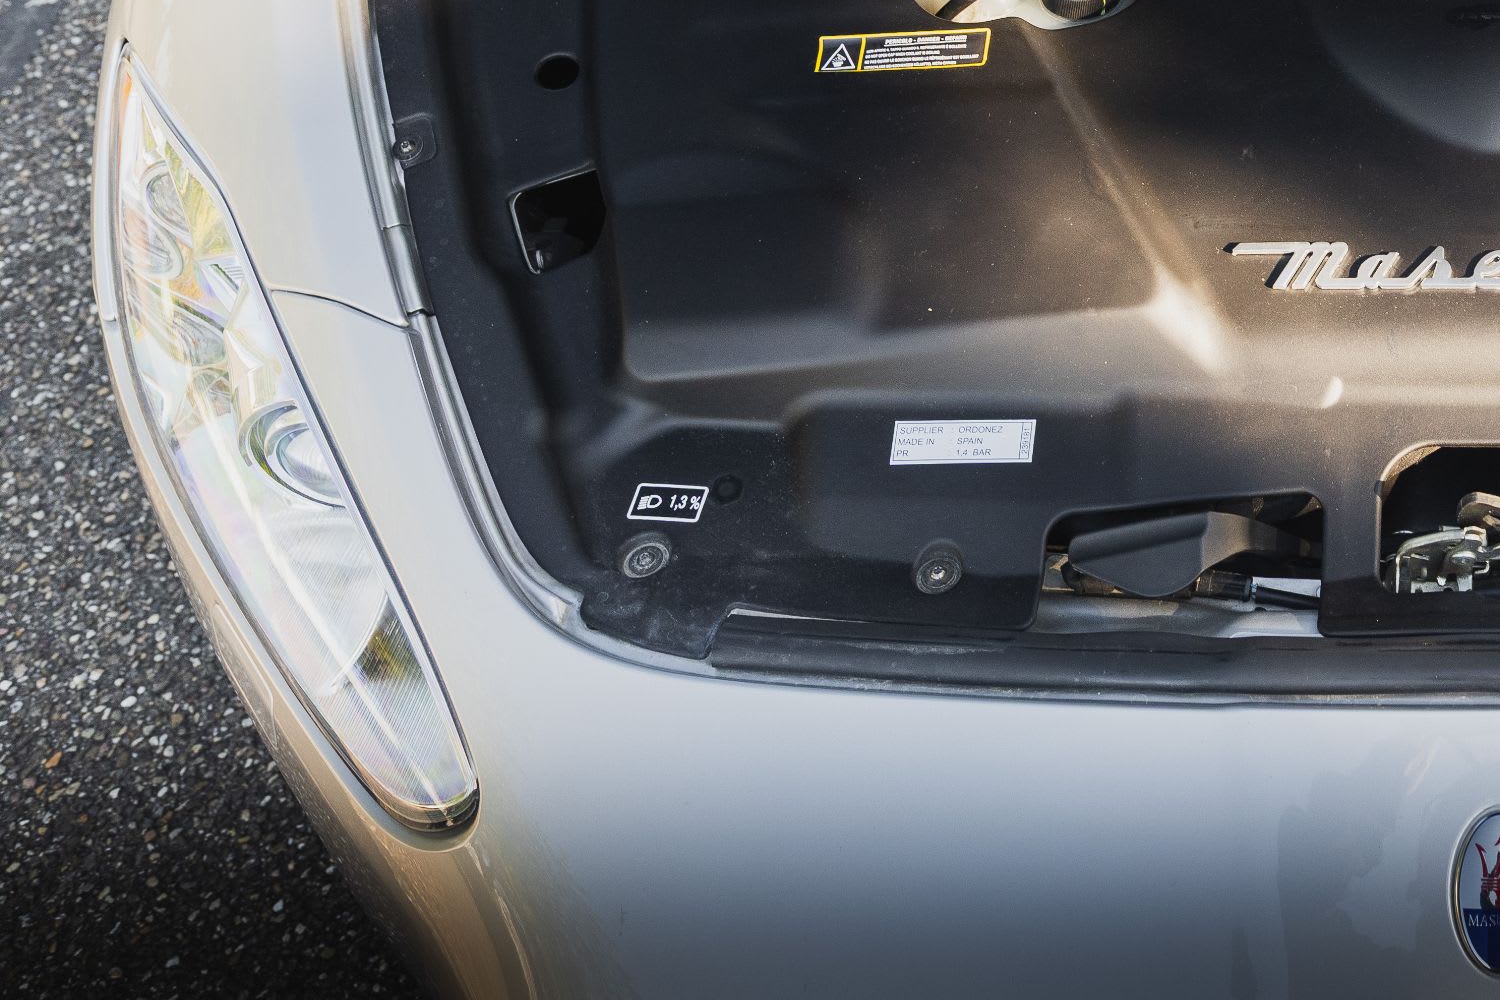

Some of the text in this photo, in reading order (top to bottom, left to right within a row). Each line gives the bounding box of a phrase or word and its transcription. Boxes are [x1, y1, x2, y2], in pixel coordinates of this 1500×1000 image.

[899, 425, 1003, 435] SUPPLIER ORDONEZ
[897, 438, 924, 446] MADE
[957, 437, 983, 445] SPAIN
[896, 449, 909, 457] PR
[972, 448, 992, 456] BAR
